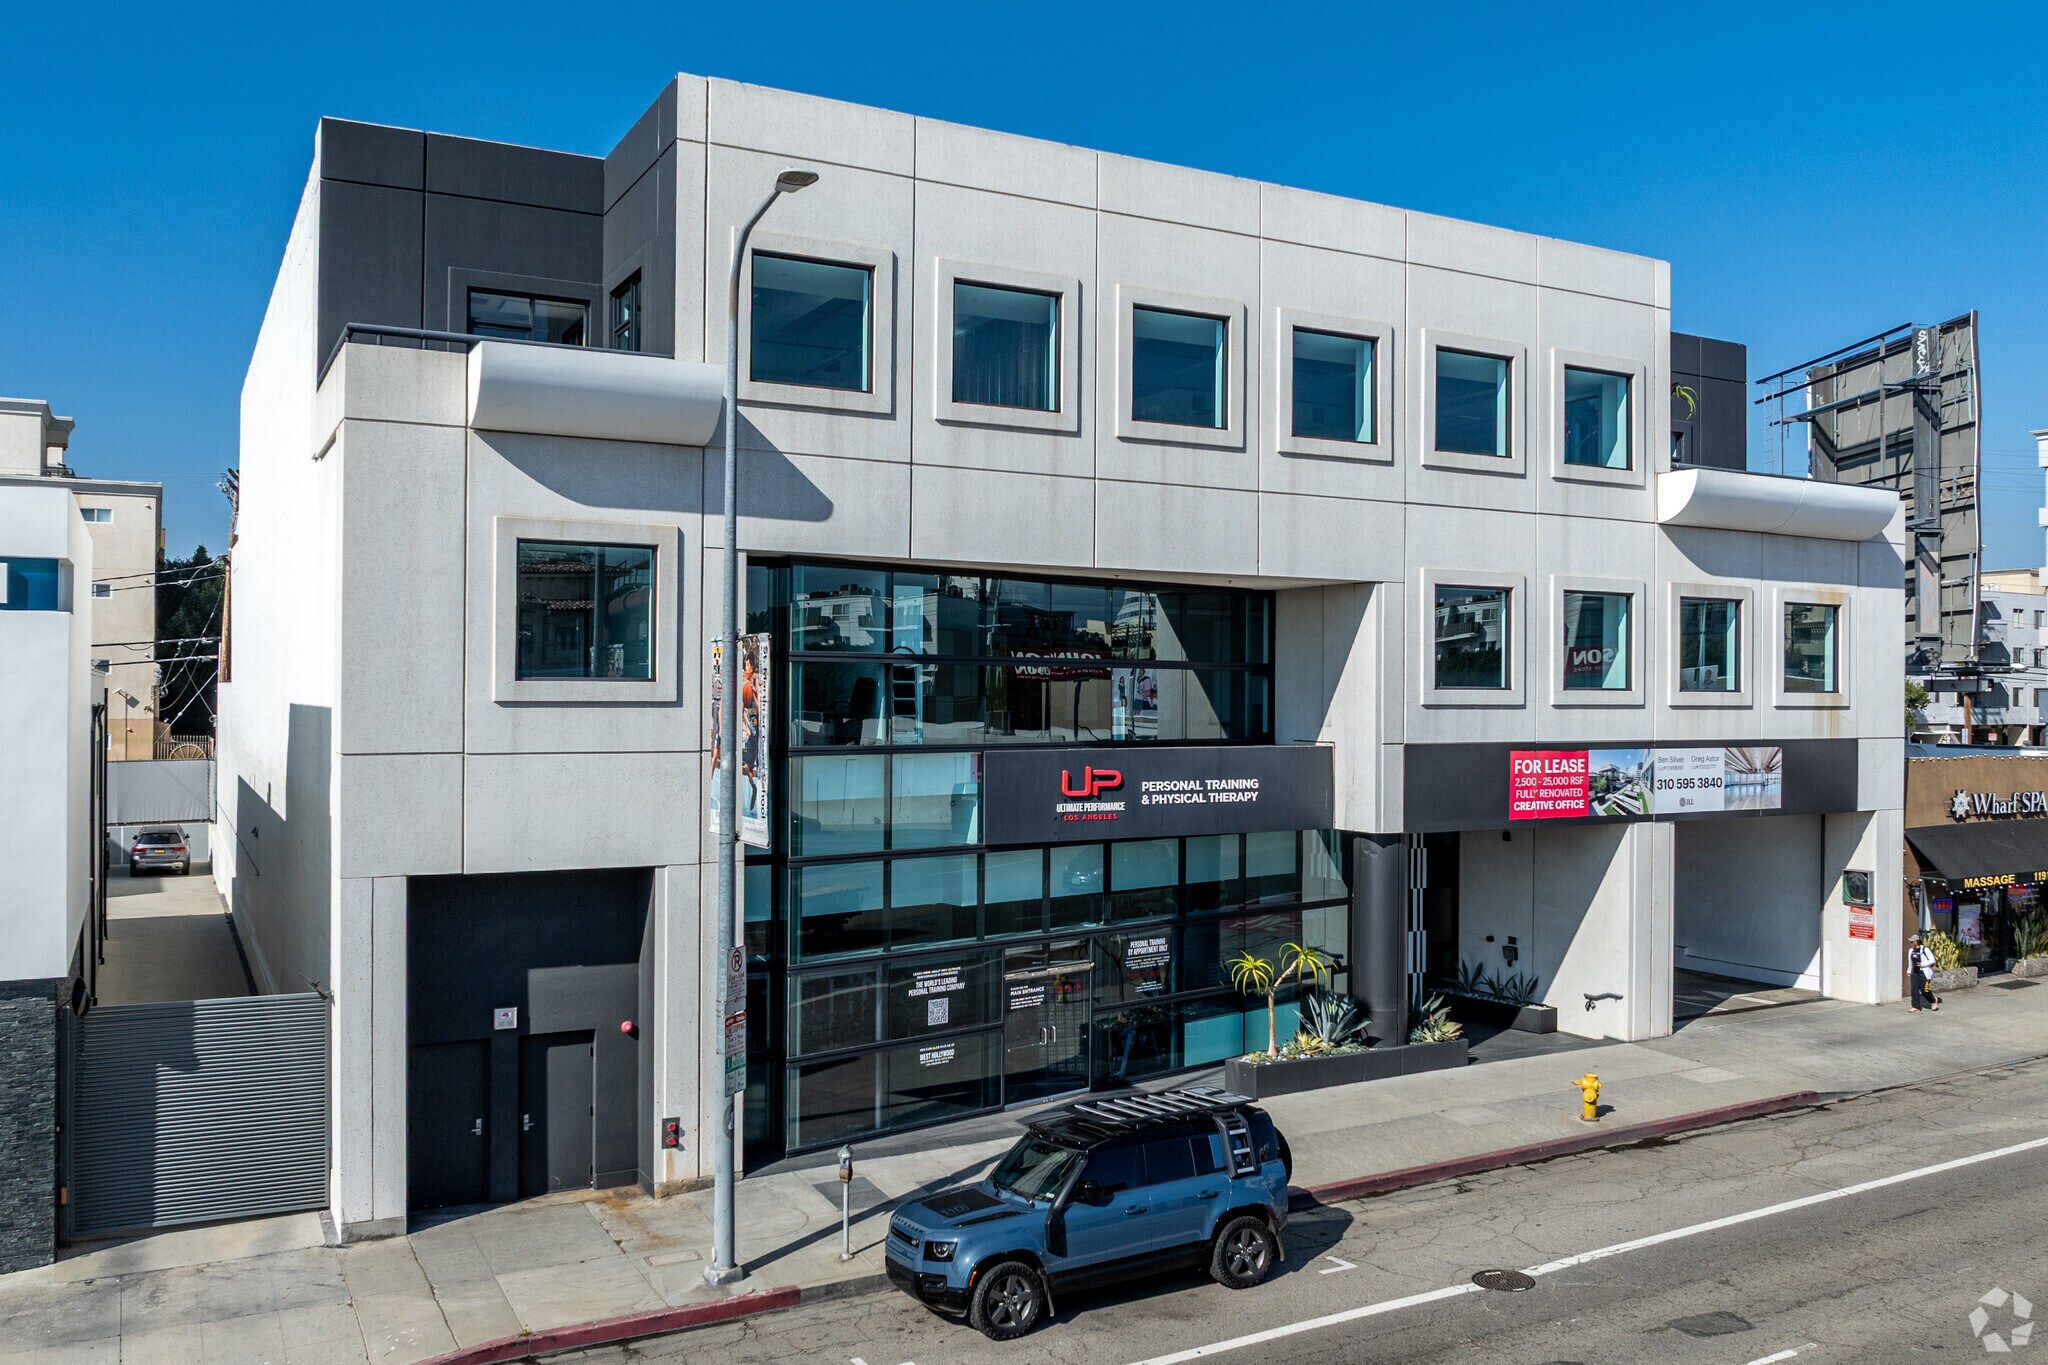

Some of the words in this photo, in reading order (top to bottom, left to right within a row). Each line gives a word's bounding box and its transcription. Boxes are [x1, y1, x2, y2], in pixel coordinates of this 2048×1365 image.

[1658, 756, 1669, 764] Ben
[1669, 756, 1685, 764] Silver
[1691, 755, 1705, 763] Greg
[1514, 759, 1542, 774] FOR
[1544, 758, 1586, 774] LEASE
[1061, 765, 1123, 797] UP
[1142, 780, 1203, 792] PERSONAL
[1205, 778, 1260, 791] TRAINING
[1515, 777, 1537, 787] 2,500
[1542, 776, 1569, 786] 25,000
[1570, 775, 1584, 785] RSF
[1656, 779, 1675, 790] 310
[1676, 778, 1695, 789] 595
[1697, 777, 1723, 788] 3840
[1141, 794, 1150, 805] &
[1153, 794, 1206, 804] PHYSICAL
[1208, 791, 1259, 803] THERAPY
[1515, 789, 1538, 799] FULLY
[1539, 788, 1583, 798] RENOVATED
[1056, 802, 1083, 813] ULTIMATE
[1084, 801, 1126, 812] PERFORMANCE
[1513, 800, 1554, 811] CREATIVE
[1555, 799, 1585, 810] OFFICE
[1973, 792, 2020, 815] Wharf
[2022, 791, 2048, 813] SPA
[1081, 813, 1118, 821] ANGELES
[1964, 874, 2015, 889] MASSAGE
[2034, 871, 2048, 881] 119
[1130, 940, 1149, 949] PERSONAL
[1133, 945, 1159, 955] APPOINTMENT
[916, 981, 924, 989] THE
[924, 979, 941, 988] WORLD'S
[941, 976, 957, 985] LEADING
[908, 988, 929, 998] PERSONAL
[929, 984, 947, 994] TRAINING
[947, 982, 965, 992] COMPANY
[1010, 989, 1022, 997] MAIN
[1022, 986, 1045, 995] ENTRANCE
[920, 1052, 931, 1061] WEST
[931, 1049, 955, 1059] HOLLYWOOD
[894, 1215, 926, 1233] DEFENDER
